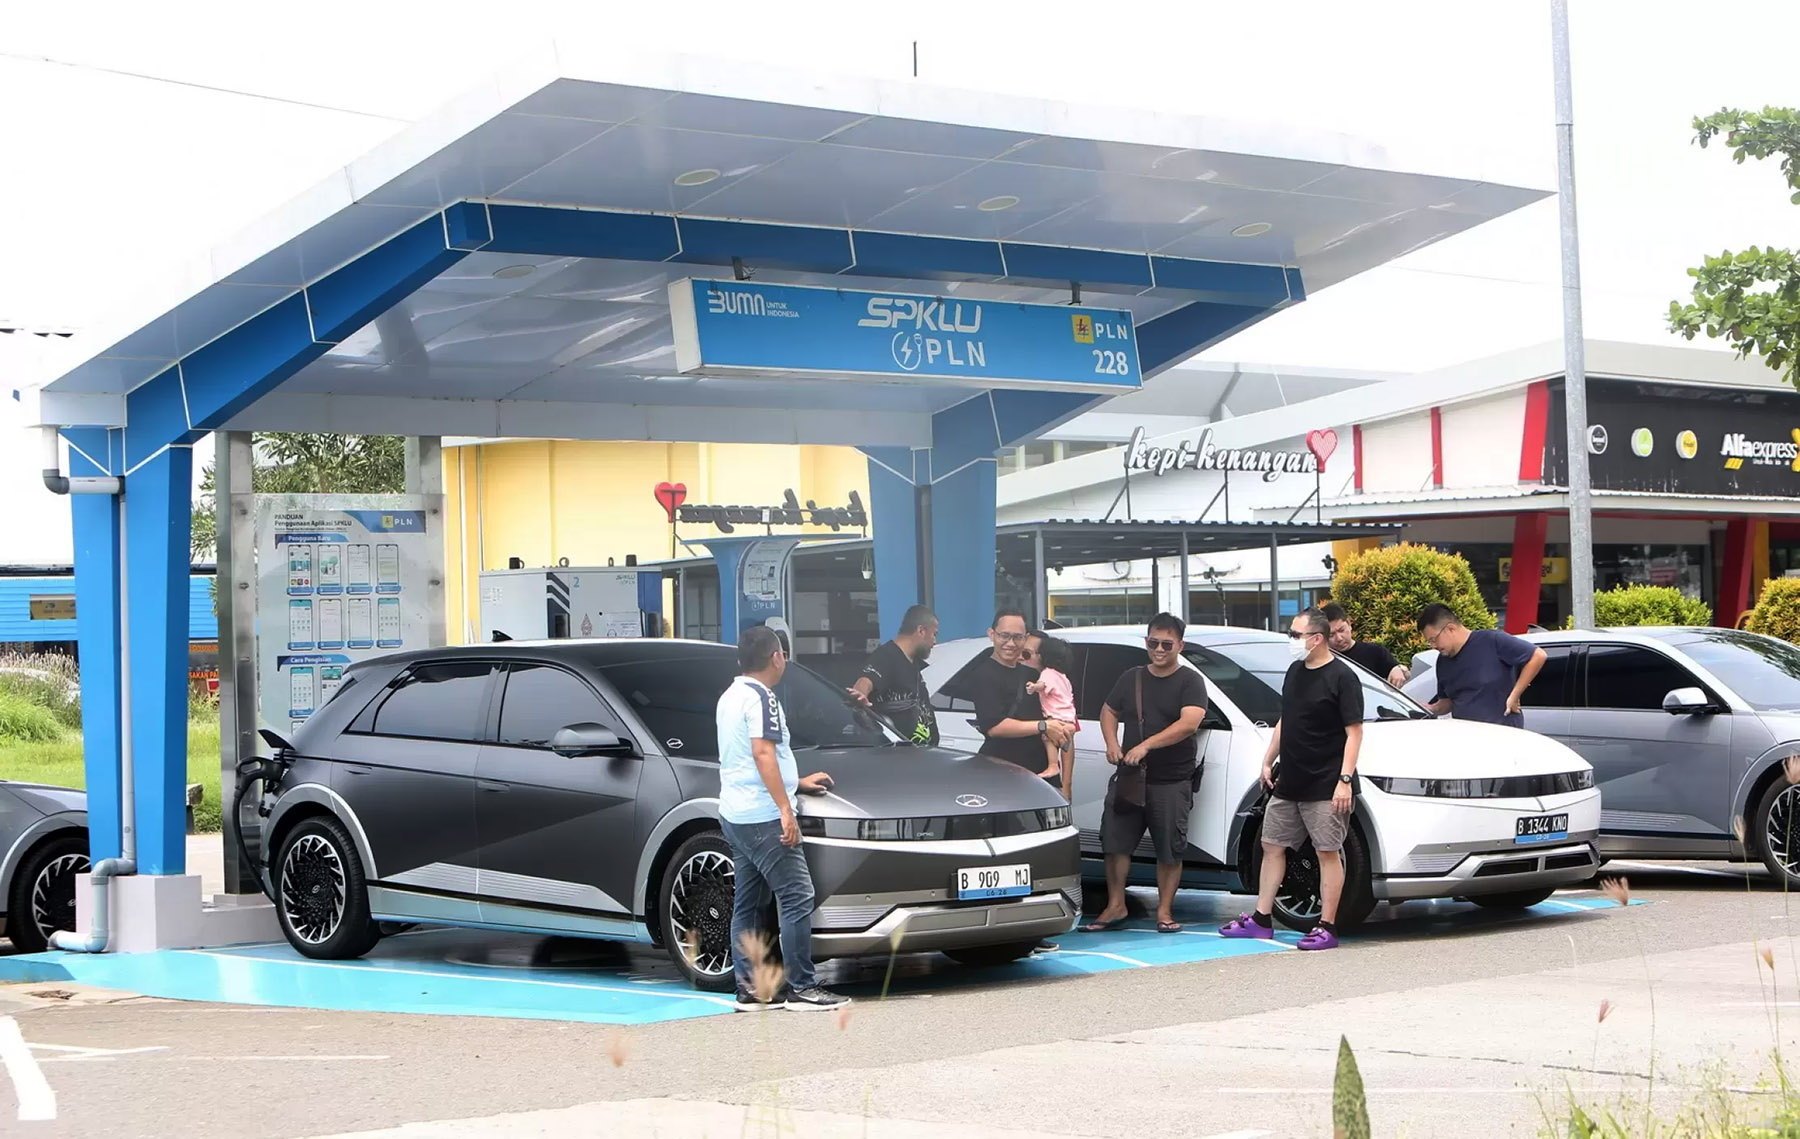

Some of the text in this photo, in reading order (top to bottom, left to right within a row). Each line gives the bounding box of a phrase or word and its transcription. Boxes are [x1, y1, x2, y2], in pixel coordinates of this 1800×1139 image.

[707, 290, 766, 316] BUMN
[767, 310, 800, 318] INDONESIA
[857, 297, 982, 333] SPKLU
[1095, 322, 1128, 340] PLN
[925, 338, 986, 367] PLN
[1092, 349, 1129, 376] 228
[574, 577, 580, 588] 2
[1517, 816, 1567, 835] B 1344 KNO
[961, 868, 1028, 889] B 909 MJ
